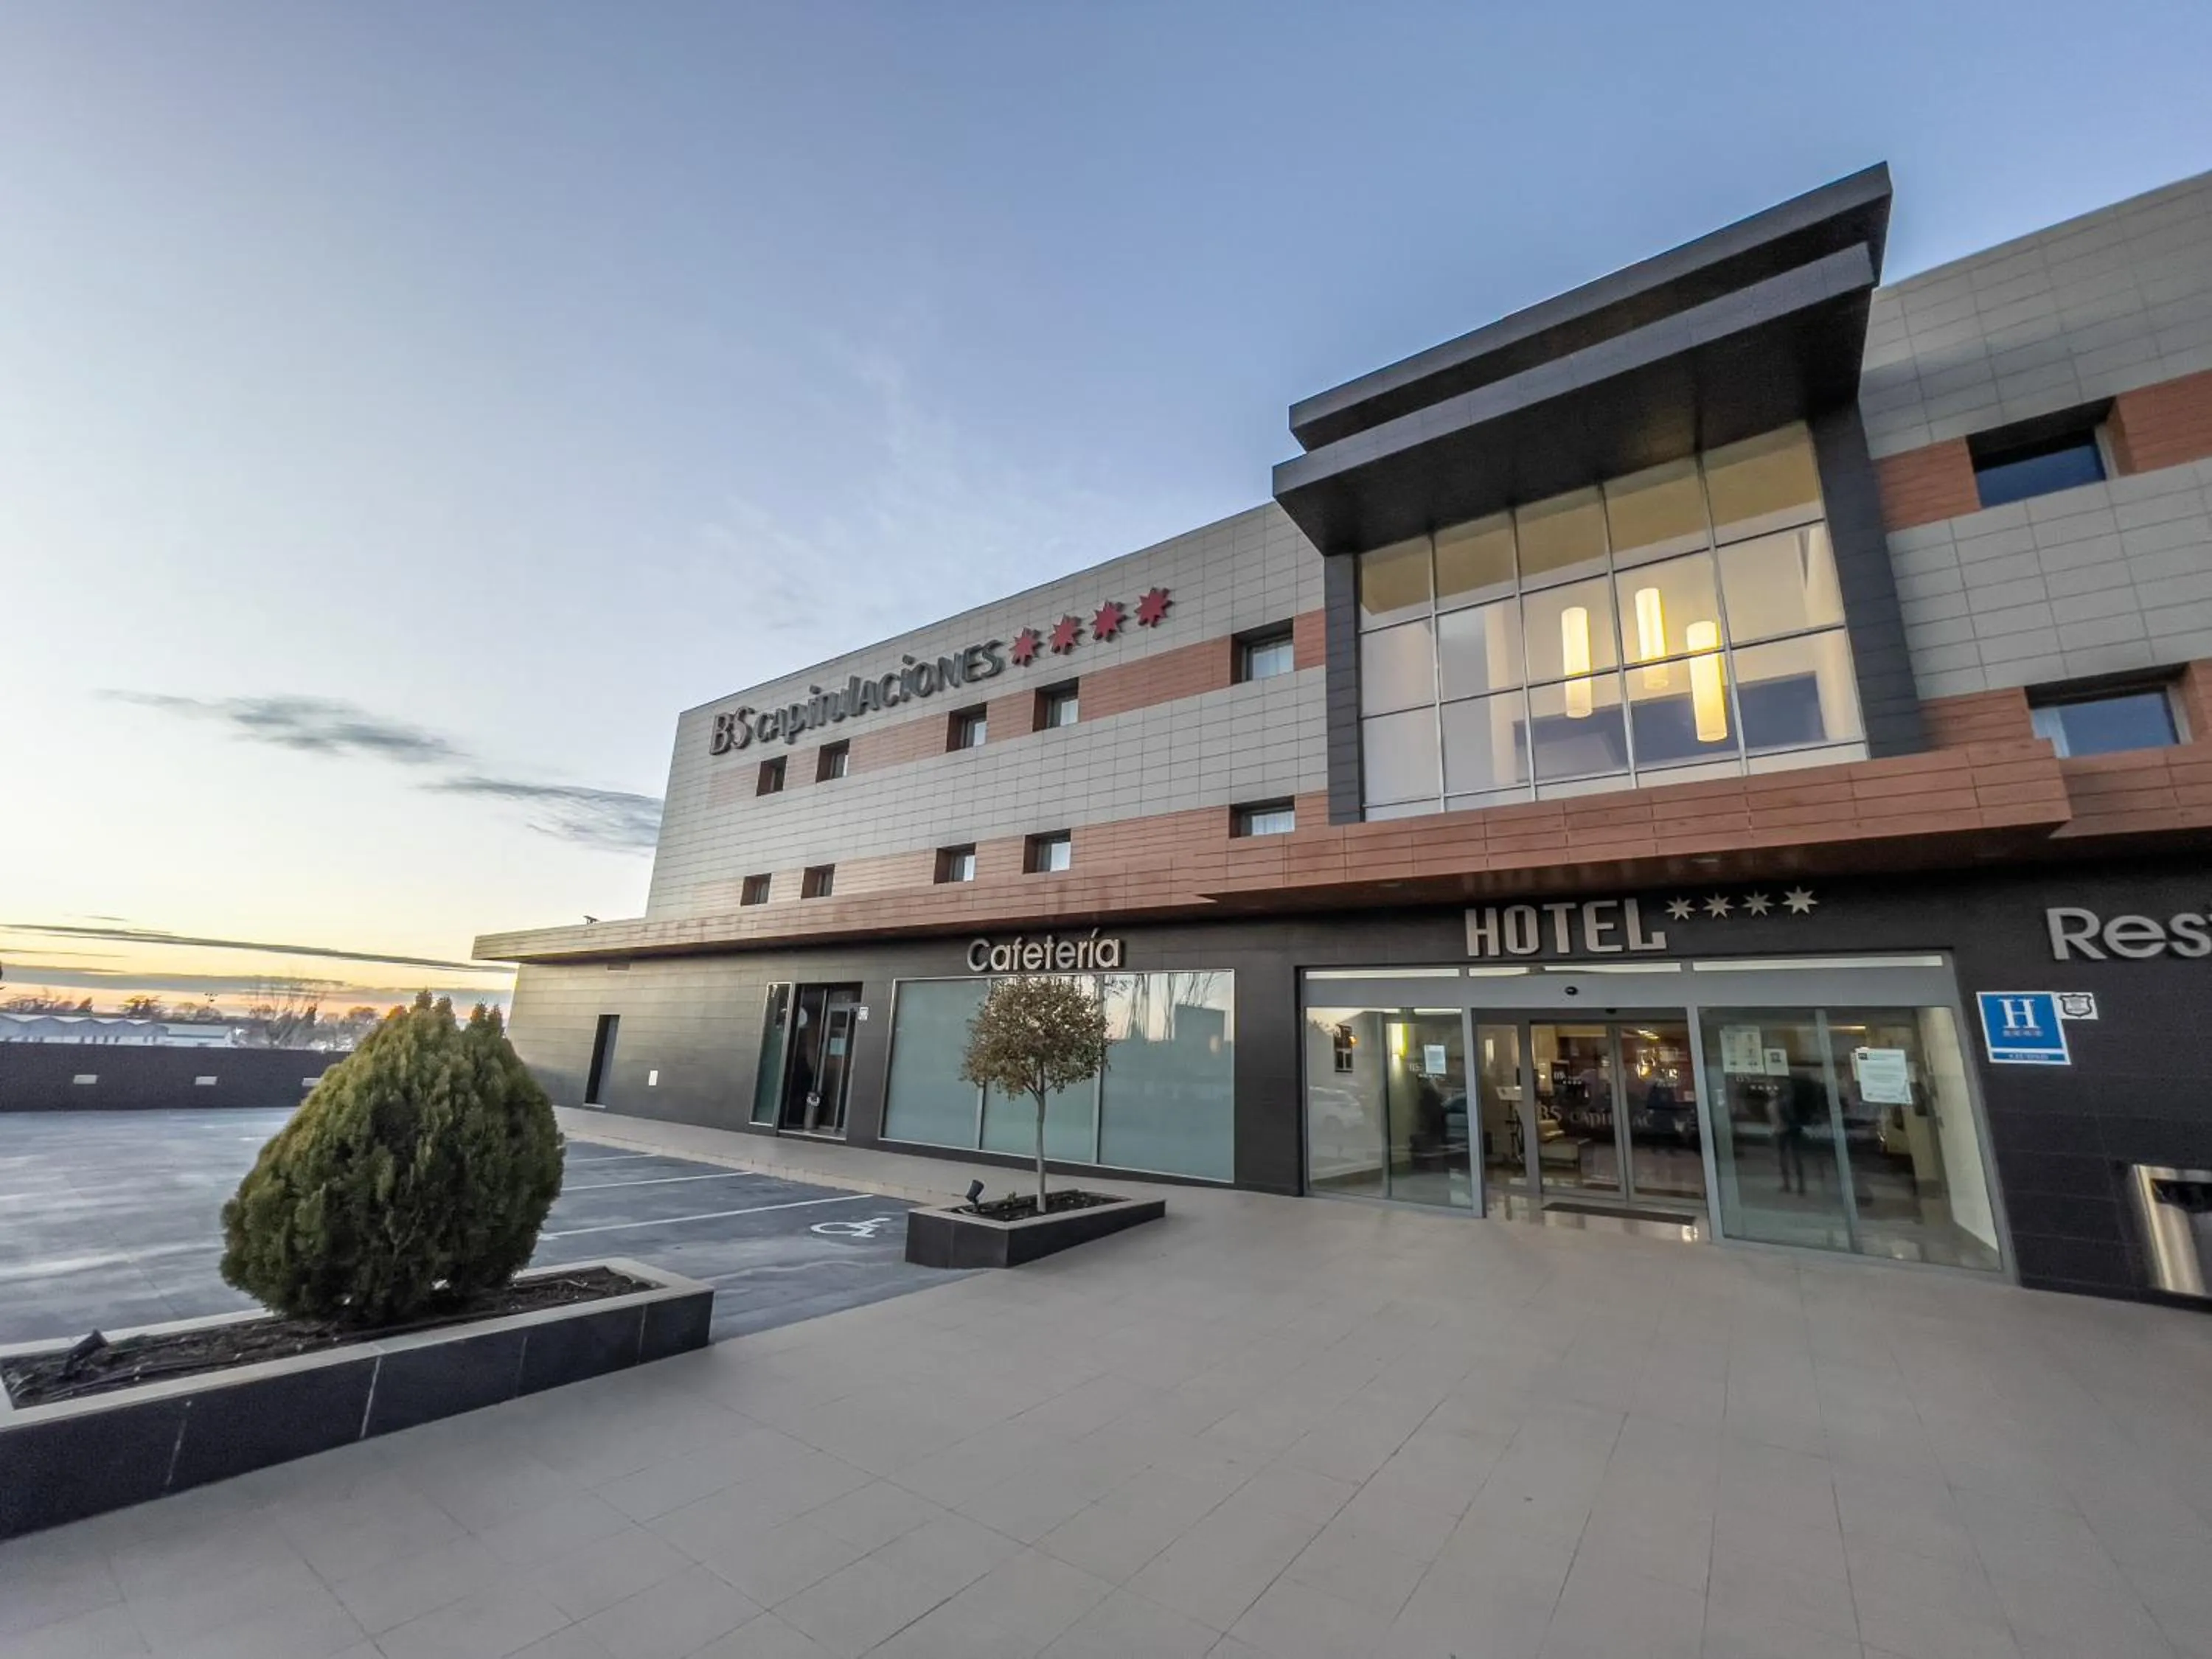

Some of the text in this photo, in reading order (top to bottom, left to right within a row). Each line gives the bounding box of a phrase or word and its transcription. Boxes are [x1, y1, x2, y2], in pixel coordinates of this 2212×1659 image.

[709, 705, 756, 755] BS
[967, 928, 1119, 972] Cafetería
[1464, 897, 1667, 956] HOTEL
[2046, 907, 2212, 959] Res
[1997, 998, 2041, 1029] H
